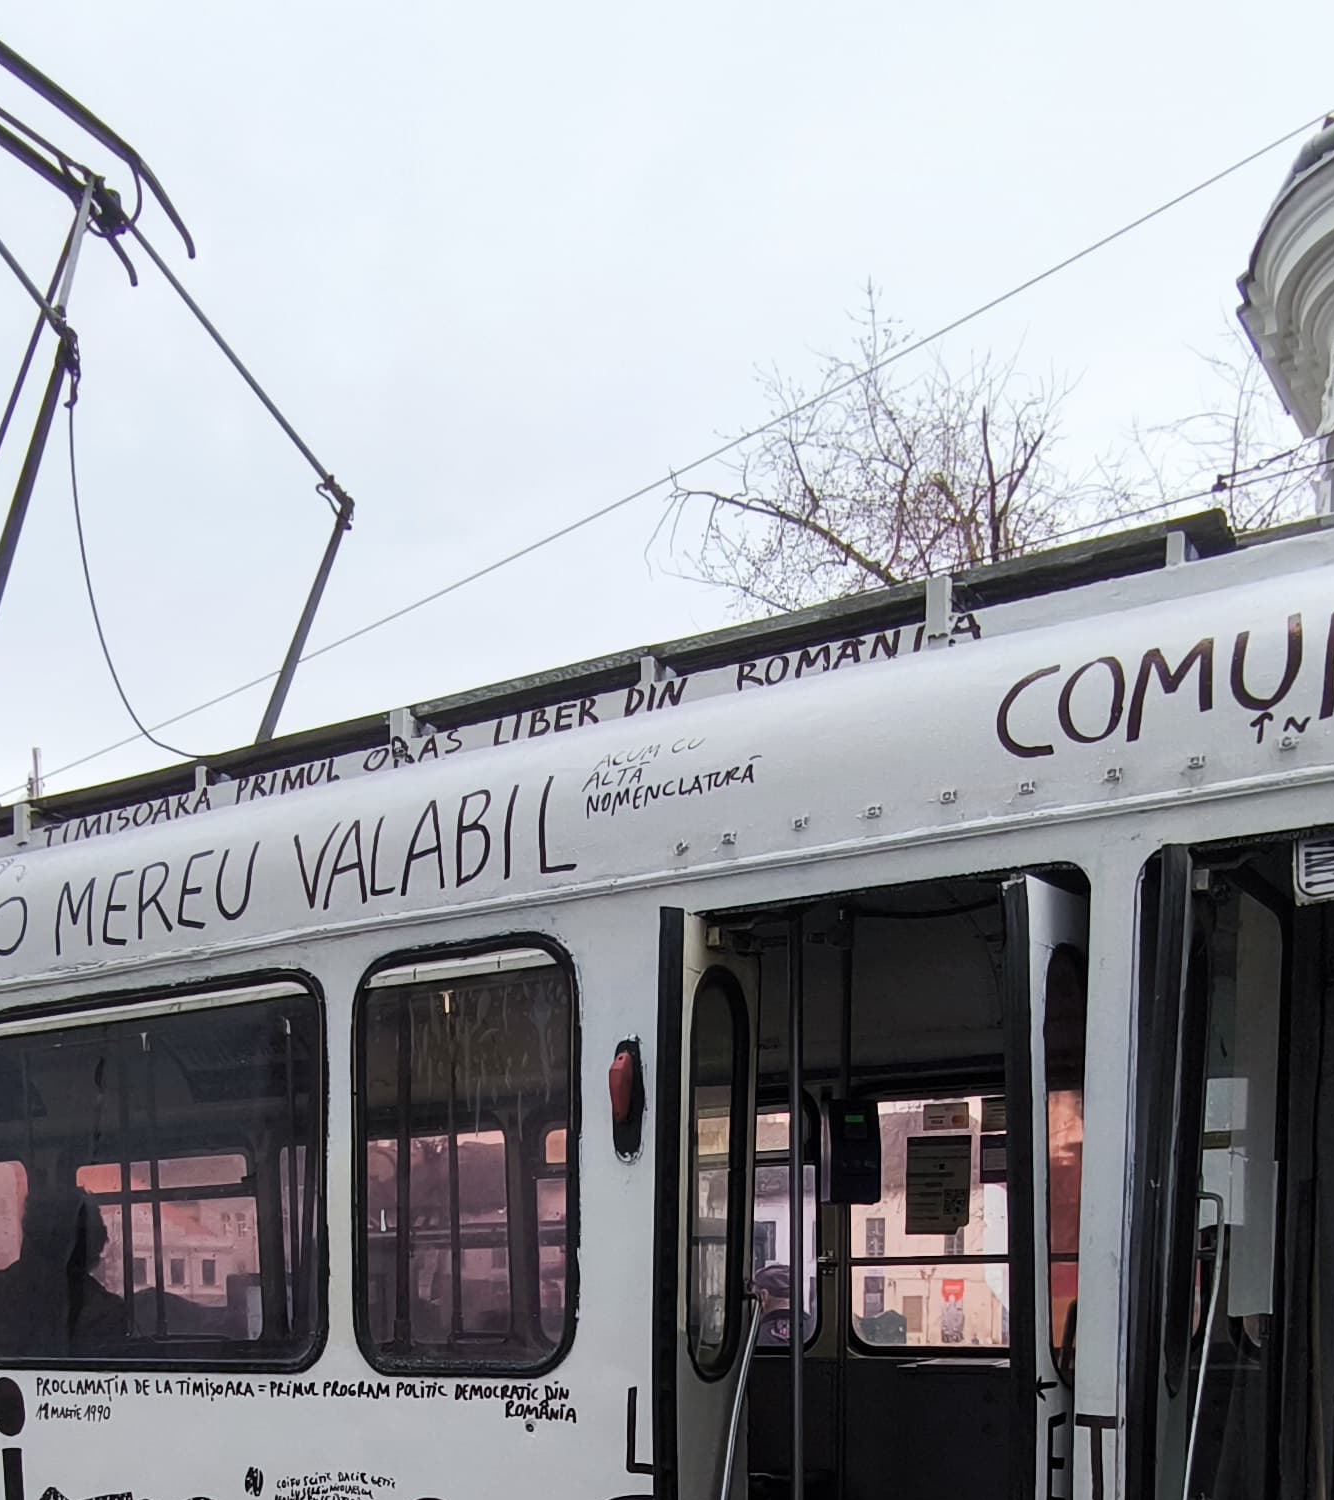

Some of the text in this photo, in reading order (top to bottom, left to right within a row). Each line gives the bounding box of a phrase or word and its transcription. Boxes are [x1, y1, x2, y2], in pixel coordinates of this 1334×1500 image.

[235, 759, 340, 806] PRIMUL
[493, 695, 599, 745] LIBER
[624, 678, 688, 717] DIN
[55, 842, 260, 955] MEREU
[293, 775, 578, 911] VALABIL
[83, 1404, 111, 1421] 1990
[135, 1379, 152, 1396] DE
[155, 1379, 174, 1395] LA
[269, 1381, 319, 1398] PRIMUL
[323, 1382, 390, 1399] PROGRAM
[396, 1381, 447, 1398] POLITIC
[544, 1380, 570, 1400] DIN
